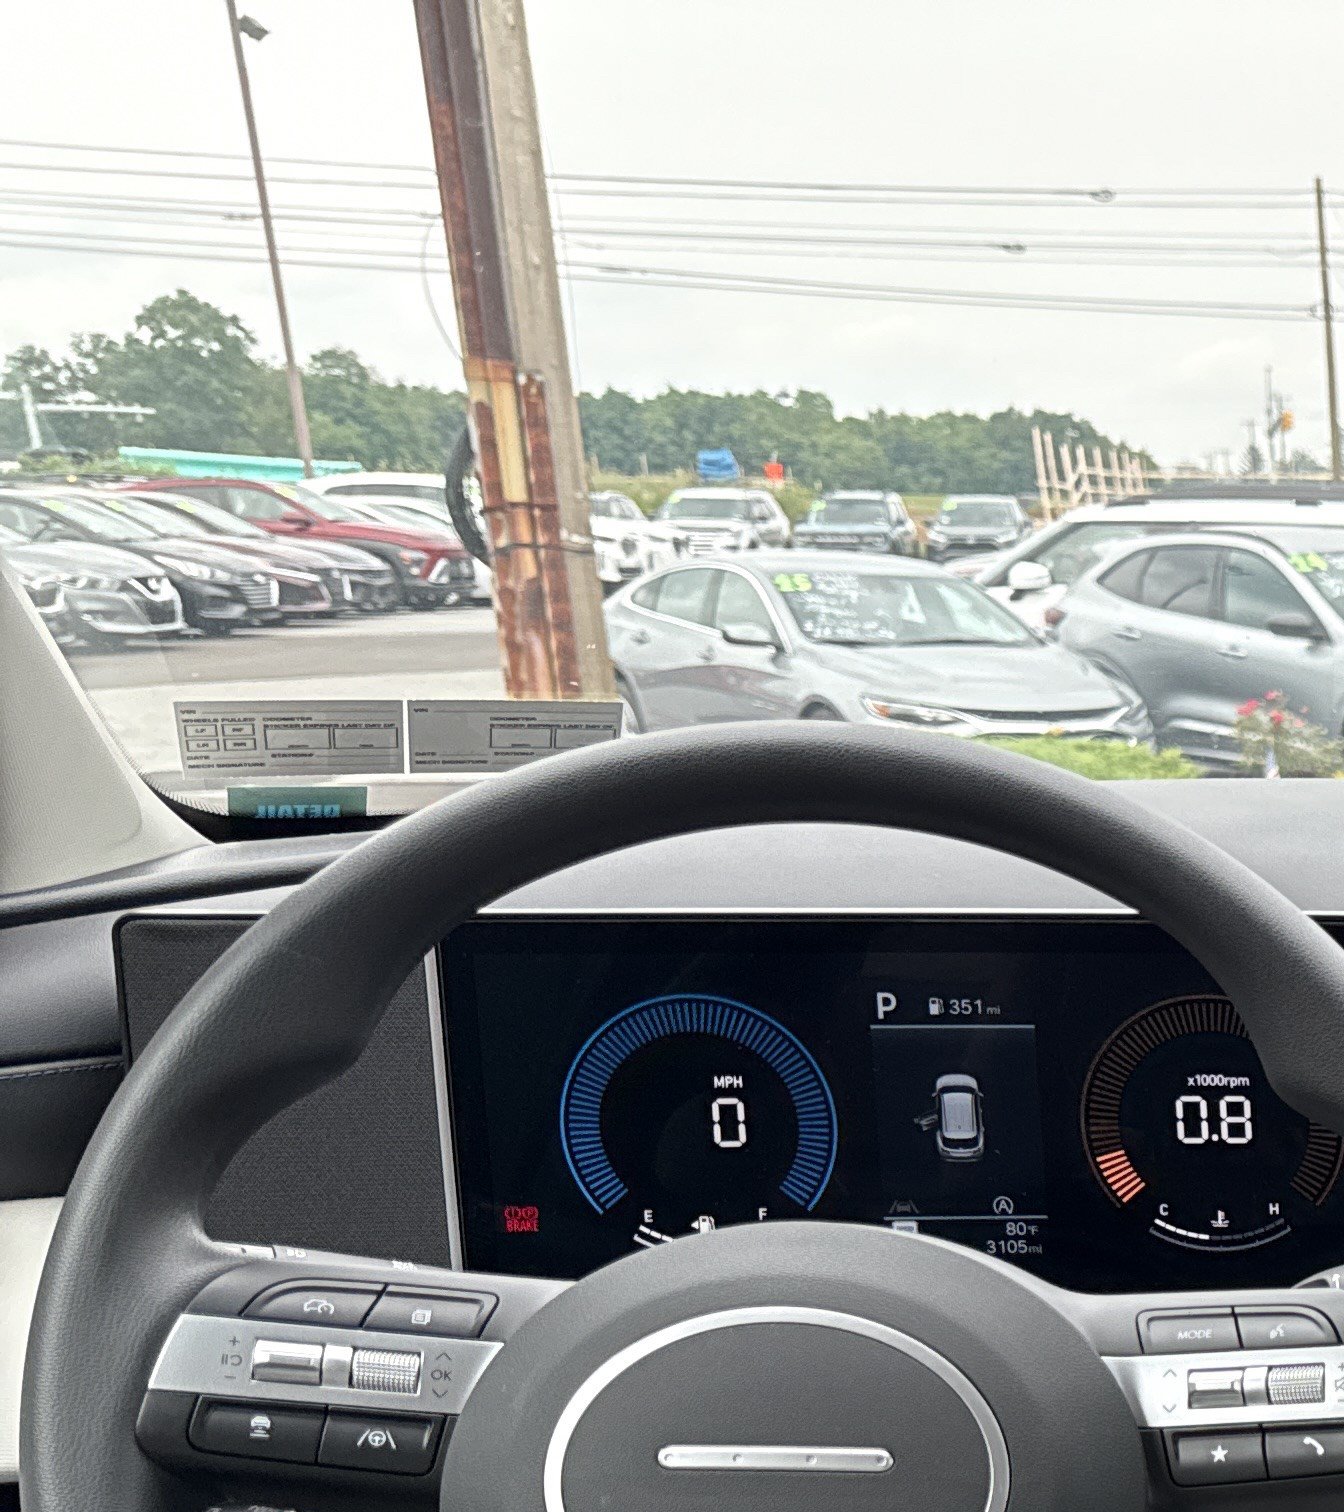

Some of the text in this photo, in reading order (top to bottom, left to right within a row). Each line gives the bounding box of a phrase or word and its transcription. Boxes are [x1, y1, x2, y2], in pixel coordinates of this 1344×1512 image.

[876, 991, 898, 1020] P
[948, 1000, 982, 1016] 351
[713, 1075, 743, 1089] MPH
[1186, 1074, 1251, 1089] x1000rpm
[711, 1097, 747, 1148] 0
[1175, 1095, 1253, 1145] 0.8
[643, 1208, 654, 1223] E
[757, 1207, 768, 1221] F
[1159, 1203, 1170, 1217] C
[1269, 1202, 1280, 1216] H
[508, 1218, 540, 1233] BRAKE
[1177, 1329, 1213, 1340] MODE
[430, 1369, 452, 1381] OK
